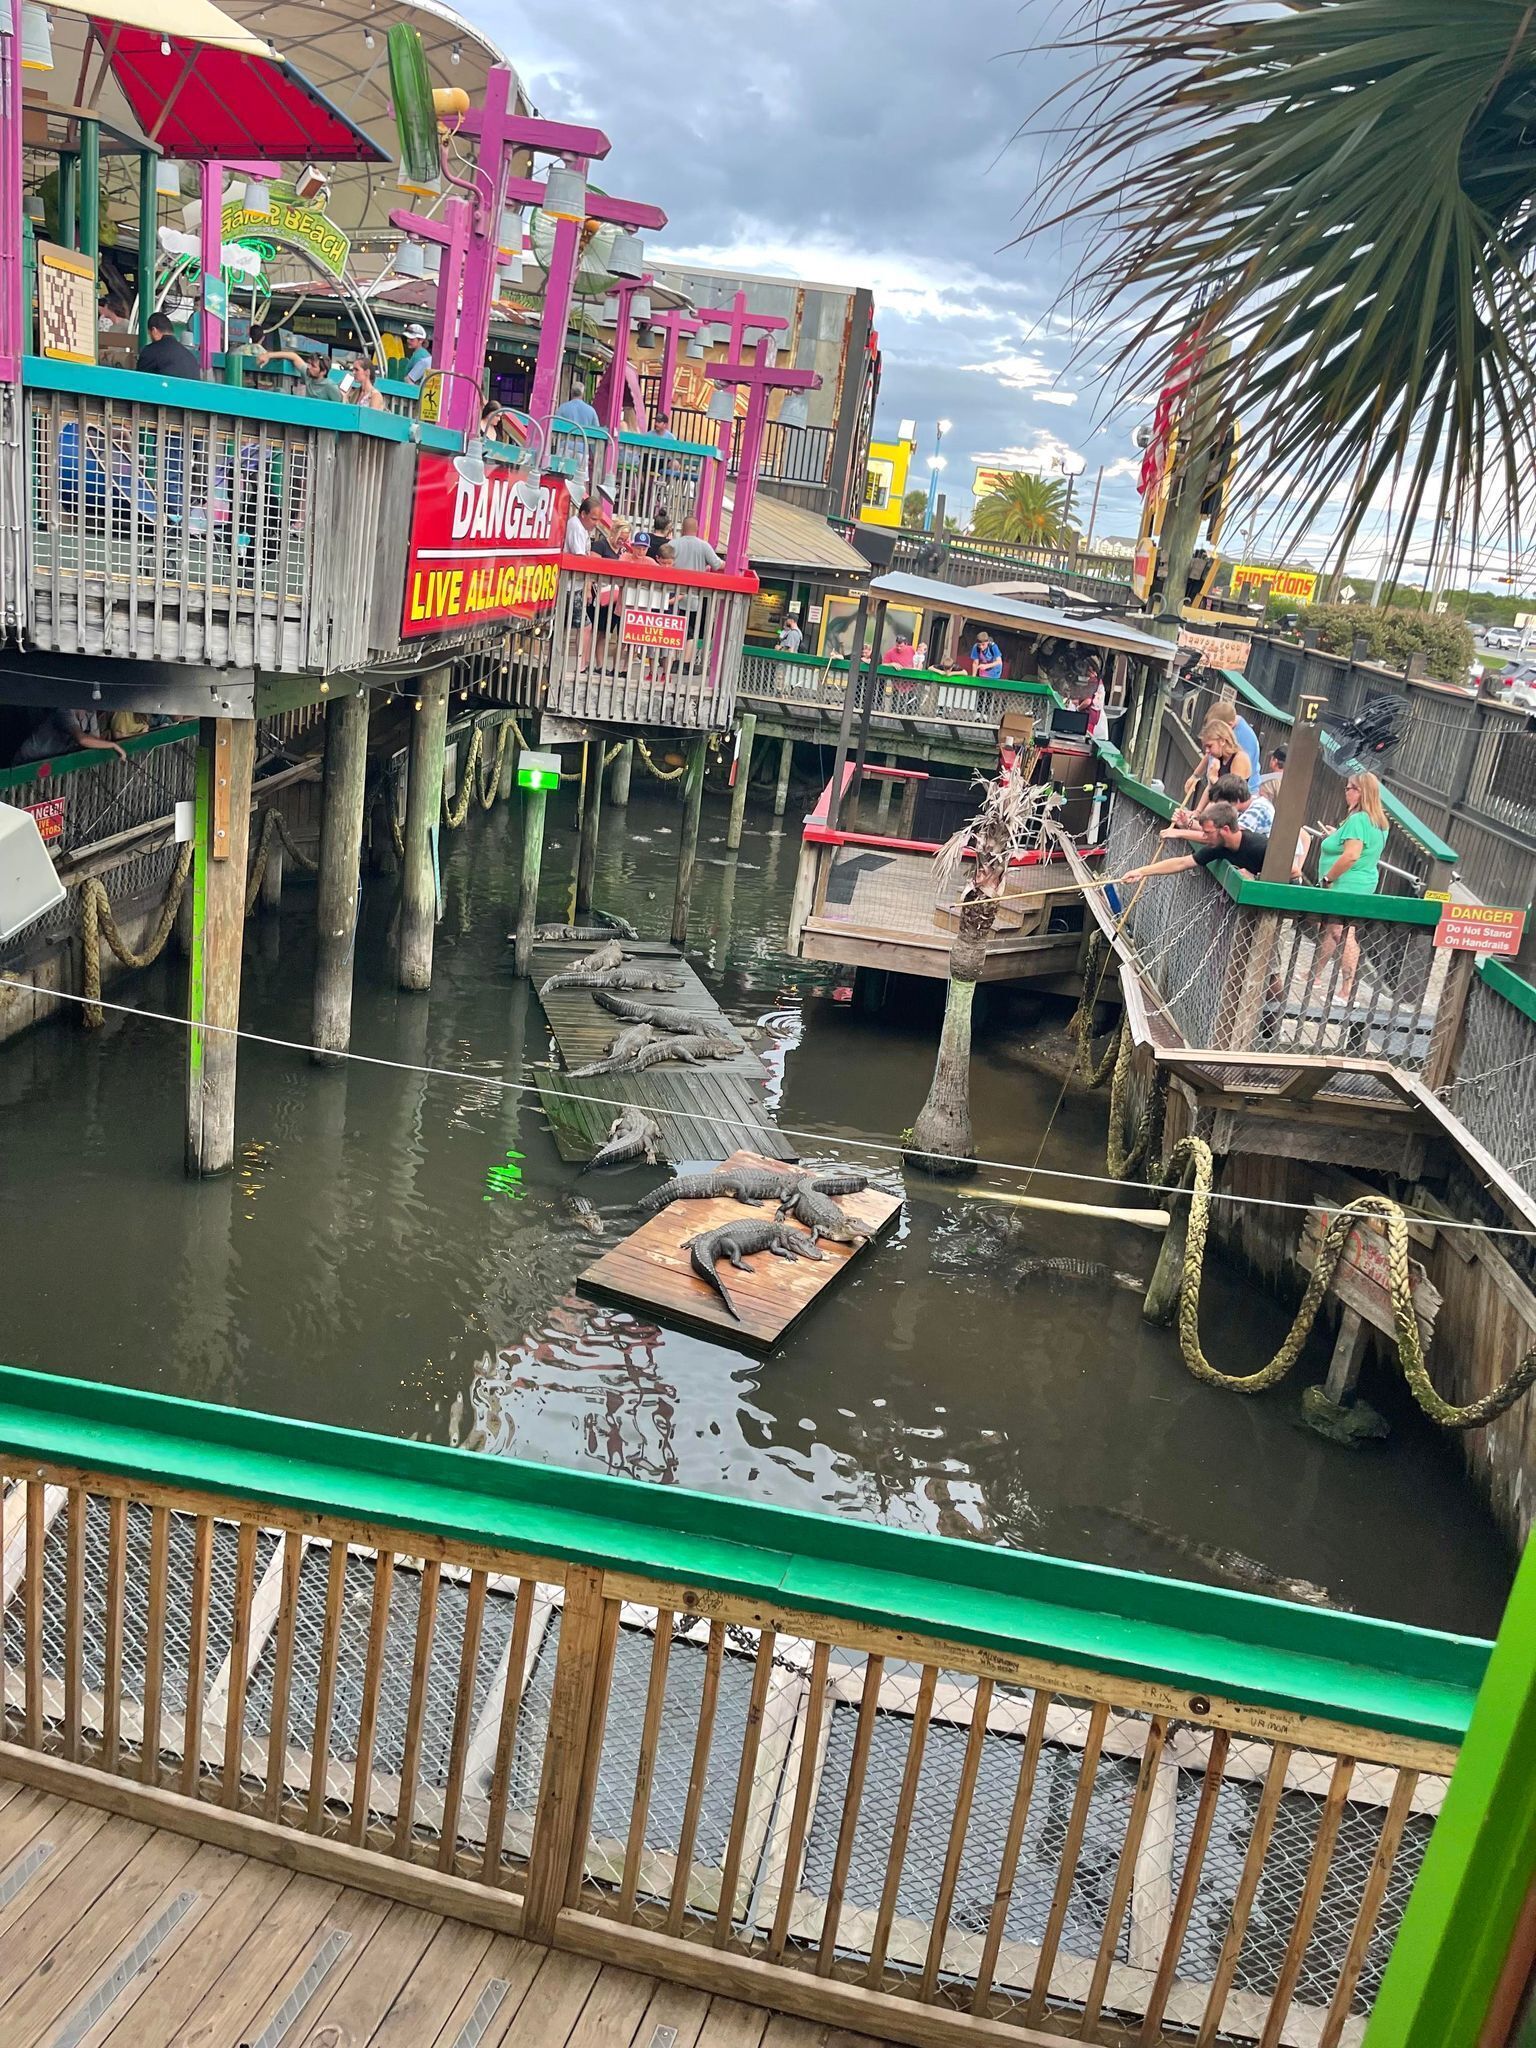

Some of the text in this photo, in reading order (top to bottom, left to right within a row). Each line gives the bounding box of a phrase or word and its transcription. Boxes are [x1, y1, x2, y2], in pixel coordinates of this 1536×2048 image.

[410, 563, 559, 621] LIVE ALLIGATORS
[627, 613, 683, 630] DANGER!
[644, 627, 664, 636] LIVE
[625, 632, 681, 646] ALLIGATORS
[38, 818, 51, 829] IVE
[1451, 906, 1514, 924] DANGER
[1446, 924, 1512, 939] Do Not Stand
[1445, 936, 1510, 950] On Handrails
